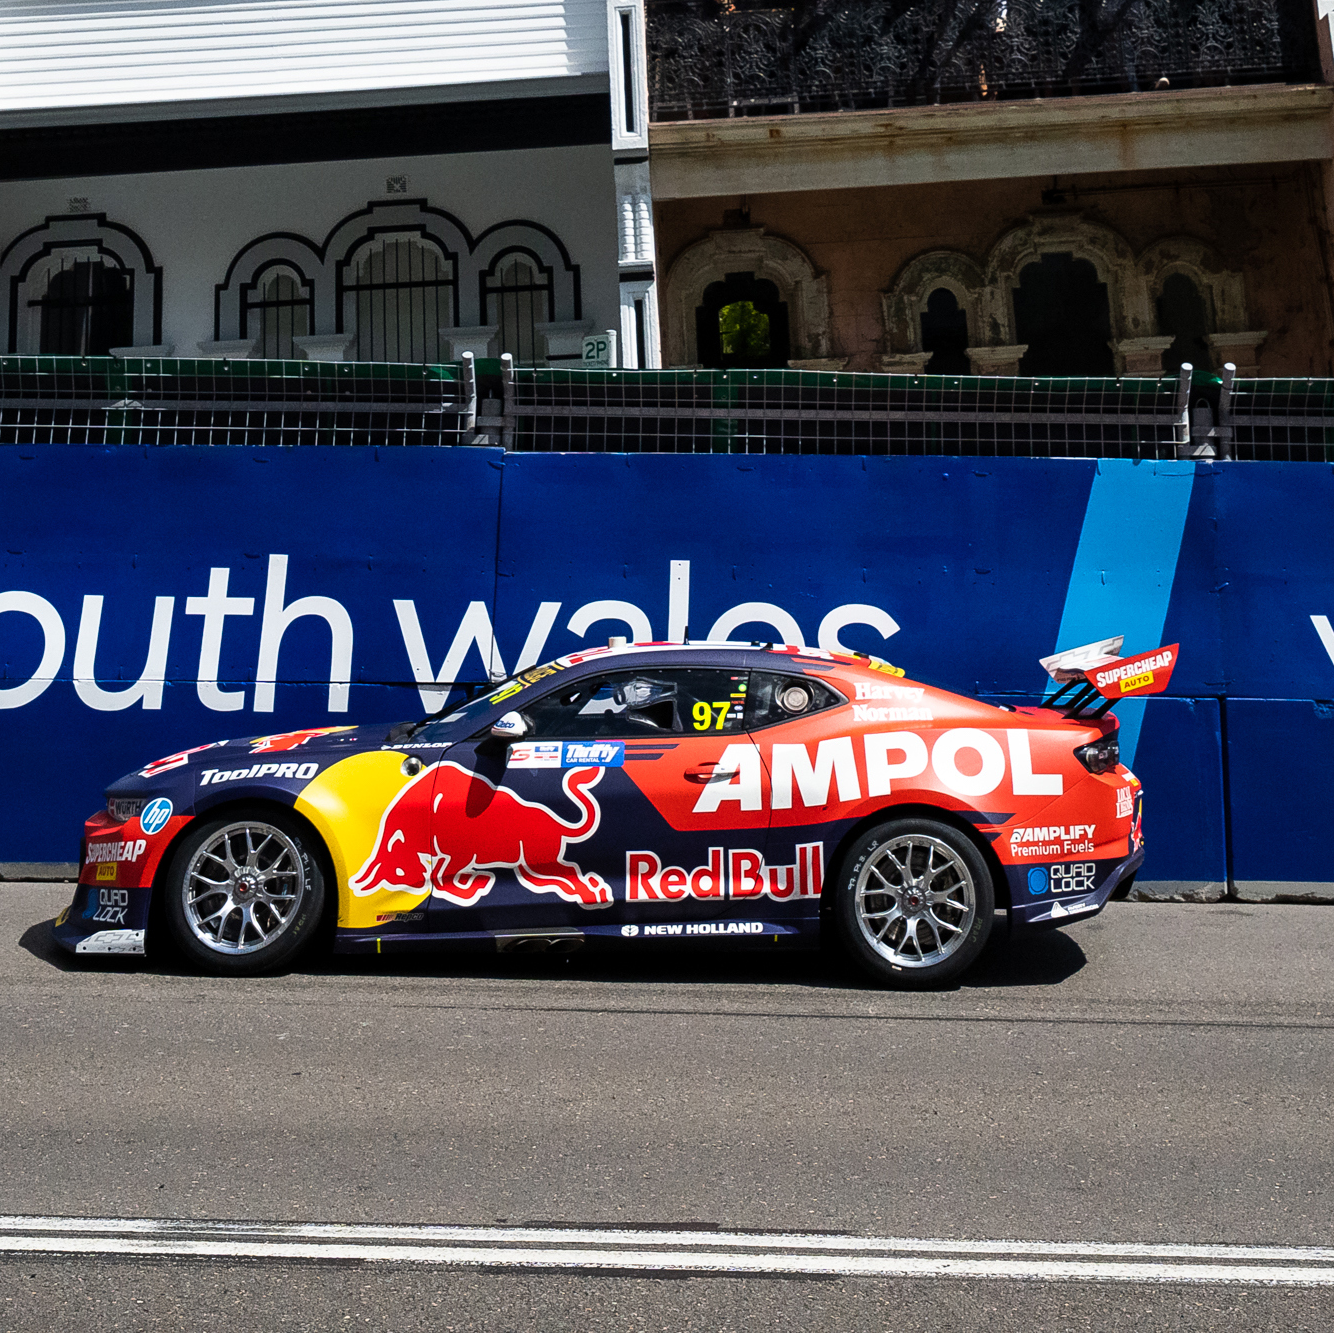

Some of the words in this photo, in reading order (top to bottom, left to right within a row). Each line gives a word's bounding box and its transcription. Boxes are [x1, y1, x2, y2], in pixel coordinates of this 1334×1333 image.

[585, 341, 607, 359] 2P
[1096, 651, 1173, 687] SUPERCHEAP
[1124, 675, 1150, 689] AUTO
[854, 682, 925, 703] Harvey
[692, 702, 731, 730] 97
[852, 704, 933, 721] Norman
[391, 742, 453, 750] DUNLOP
[566, 744, 620, 762] Thrifty
[200, 762, 318, 786] ToolPRO
[692, 728, 1063, 813] AMPOL
[143, 798, 170, 834] hp
[1022, 825, 1096, 842] AMPLIFY
[86, 839, 146, 864] SUPERCHEAP
[1011, 842, 1061, 856] Premium
[1064, 840, 1095, 854] Fuels
[97, 866, 115, 876] AUTO
[1051, 863, 1095, 878] QUAD
[1051, 876, 1095, 892] LOCK
[99, 889, 128, 906] QUAD
[93, 906, 128, 925] LOCK
[394, 913, 424, 922] Repco
[644, 924, 683, 935] NEW
[686, 922, 763, 934] HOLLAND
